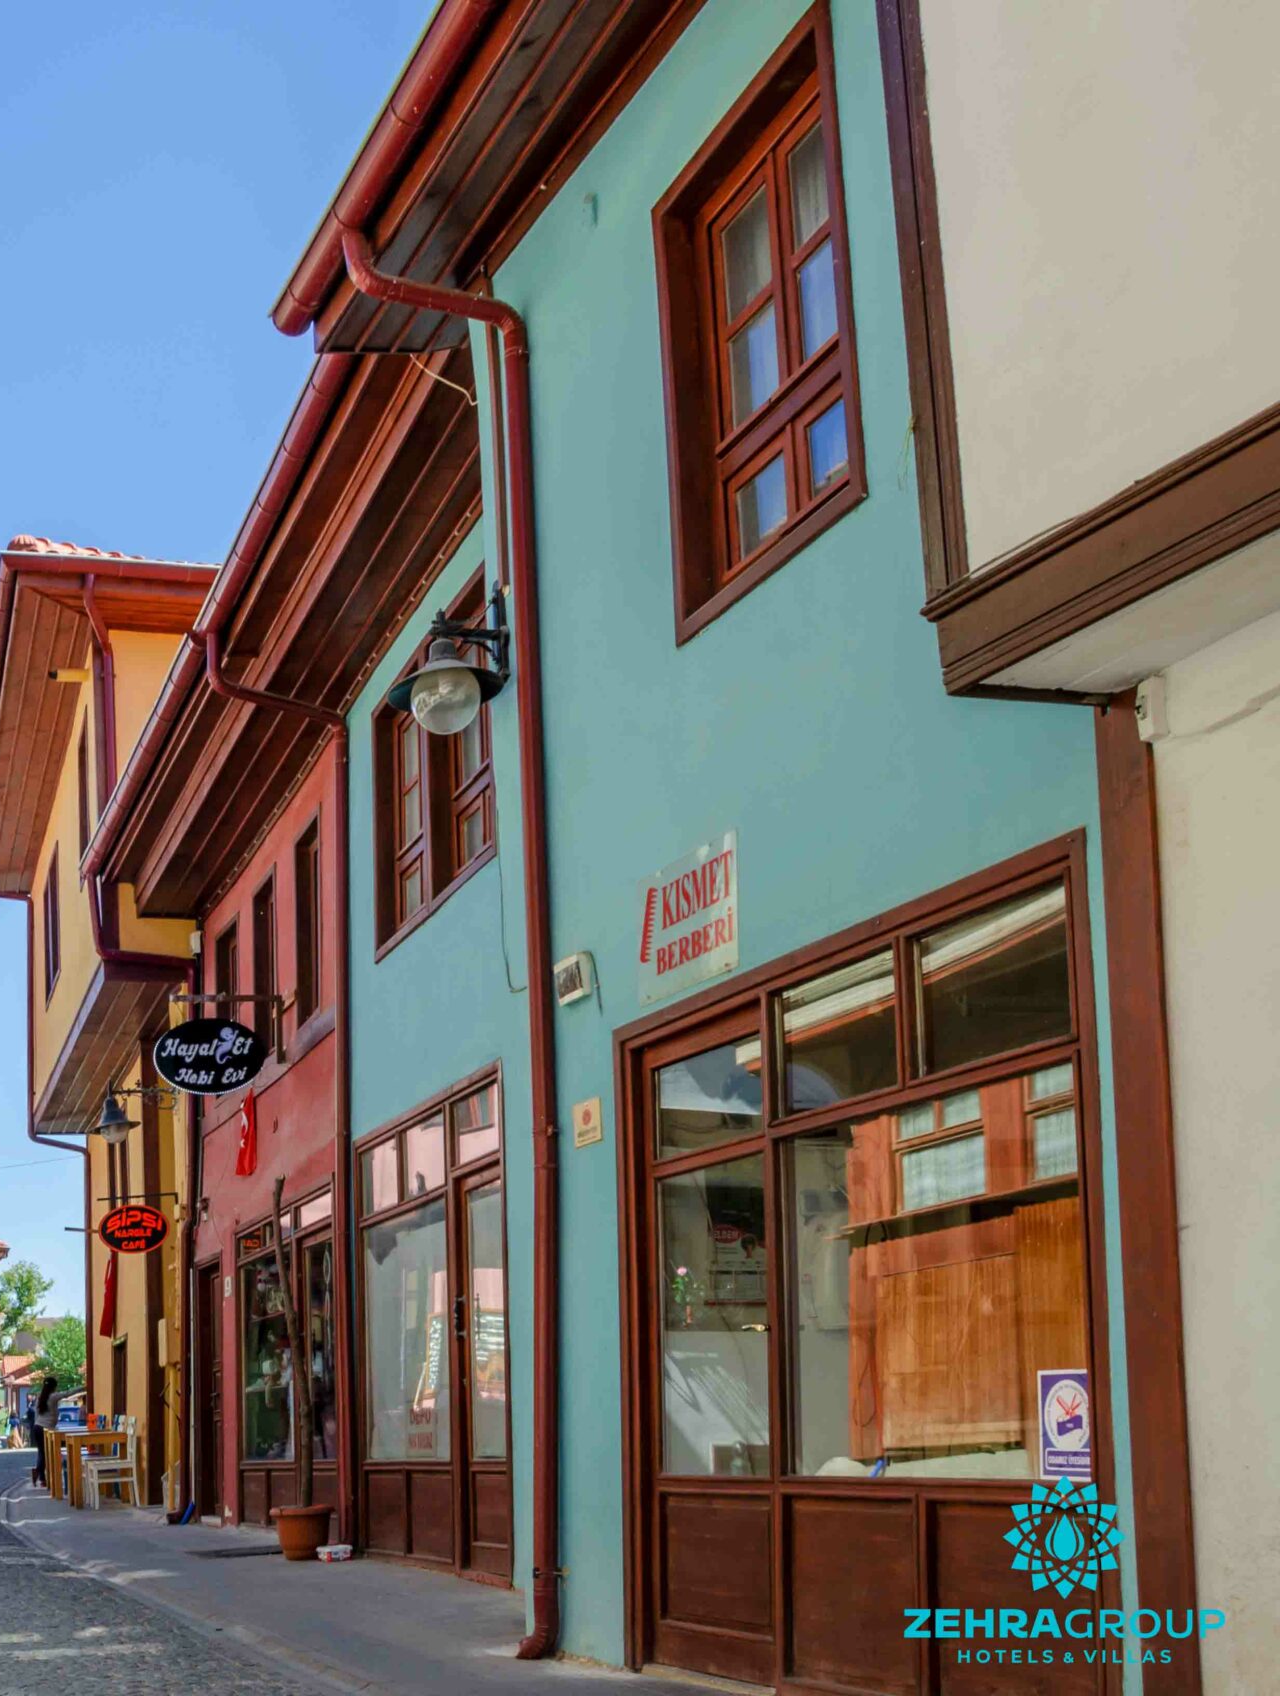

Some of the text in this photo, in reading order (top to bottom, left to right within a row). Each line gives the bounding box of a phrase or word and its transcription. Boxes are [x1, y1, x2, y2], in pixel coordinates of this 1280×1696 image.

[661, 850, 733, 930] KISMET
[656, 906, 734, 976] BERBERİ
[161, 1036, 253, 1063] Hayal Et
[221, 1066, 248, 1084] Evi
